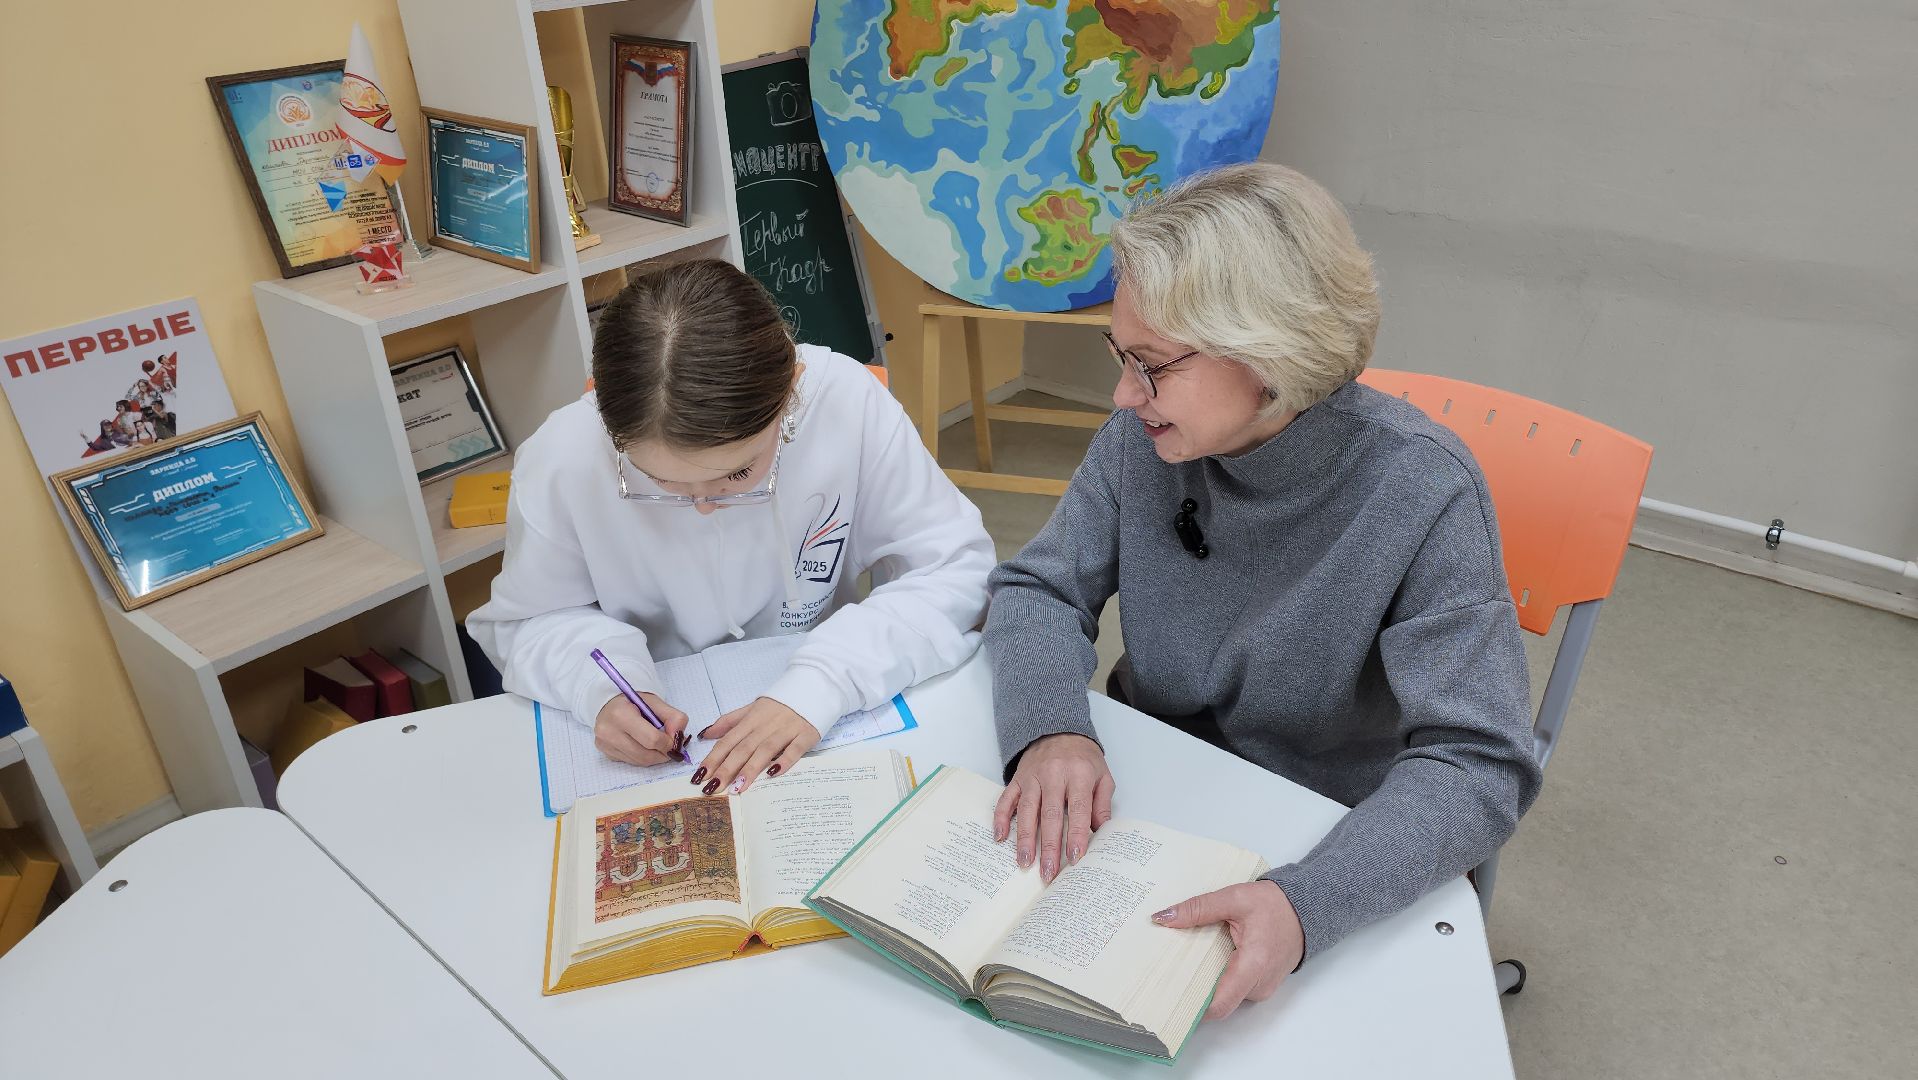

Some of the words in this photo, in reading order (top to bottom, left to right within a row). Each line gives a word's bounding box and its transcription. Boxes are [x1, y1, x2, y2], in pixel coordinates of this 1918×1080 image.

[640, 91, 669, 103] ГРАМОТА
[265, 129, 344, 155] ДИПЛОМ
[461, 157, 496, 175] ДИПЛОМ
[4, 310, 196, 378] ПЕРВЫЕ
[152, 471, 218, 503] ДИПЛОМ
[802, 560, 827, 572] 2025
[780, 609, 819, 620] КОНКУРС
